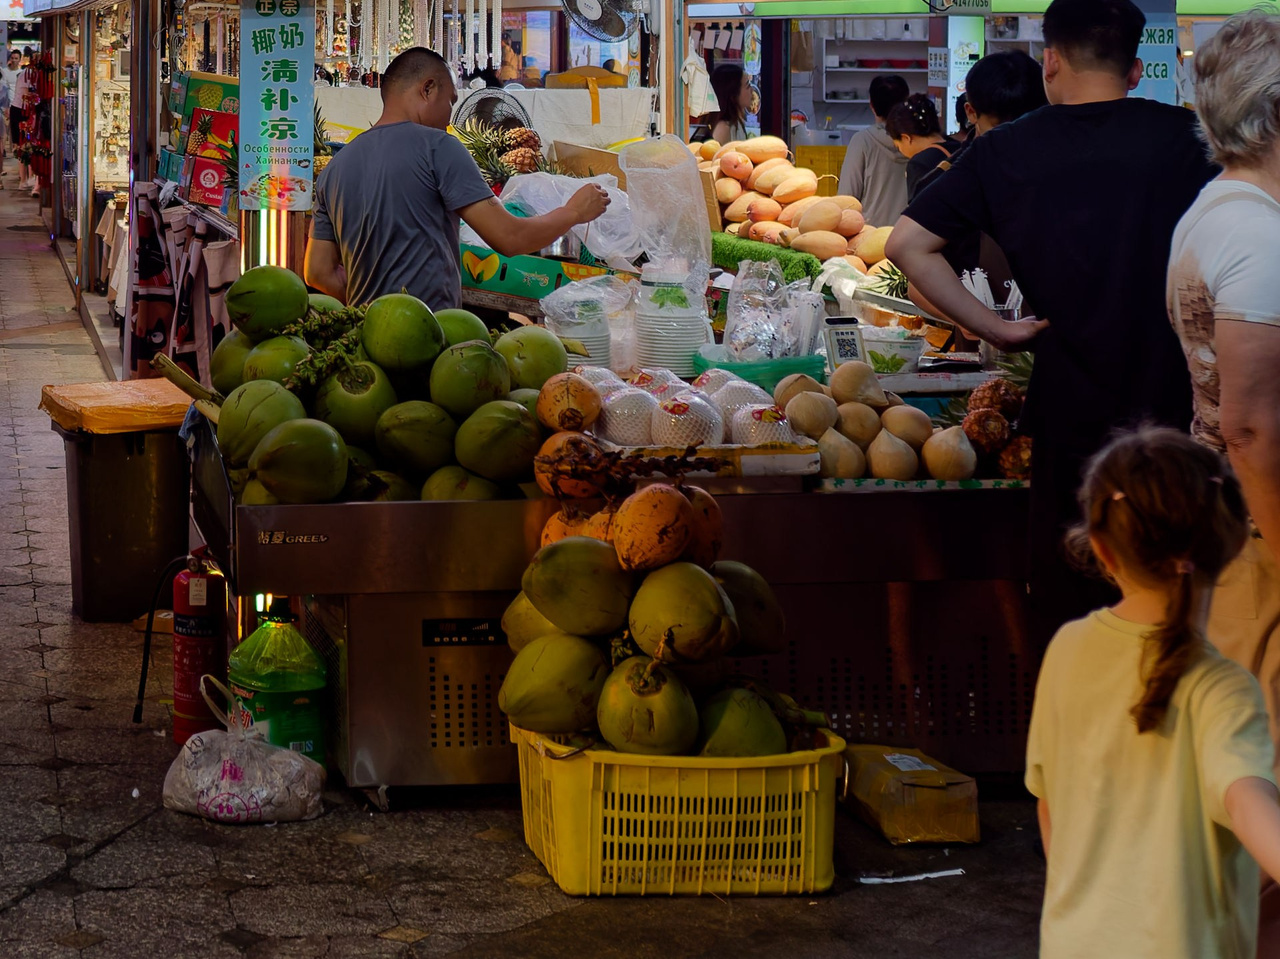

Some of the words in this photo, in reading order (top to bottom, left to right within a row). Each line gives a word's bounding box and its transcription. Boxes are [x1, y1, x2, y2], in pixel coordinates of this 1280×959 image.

[260, 58, 299, 141] 清补凉
[243, 143, 310, 154] Особенности
[256, 154, 298, 166] Хайнаня
